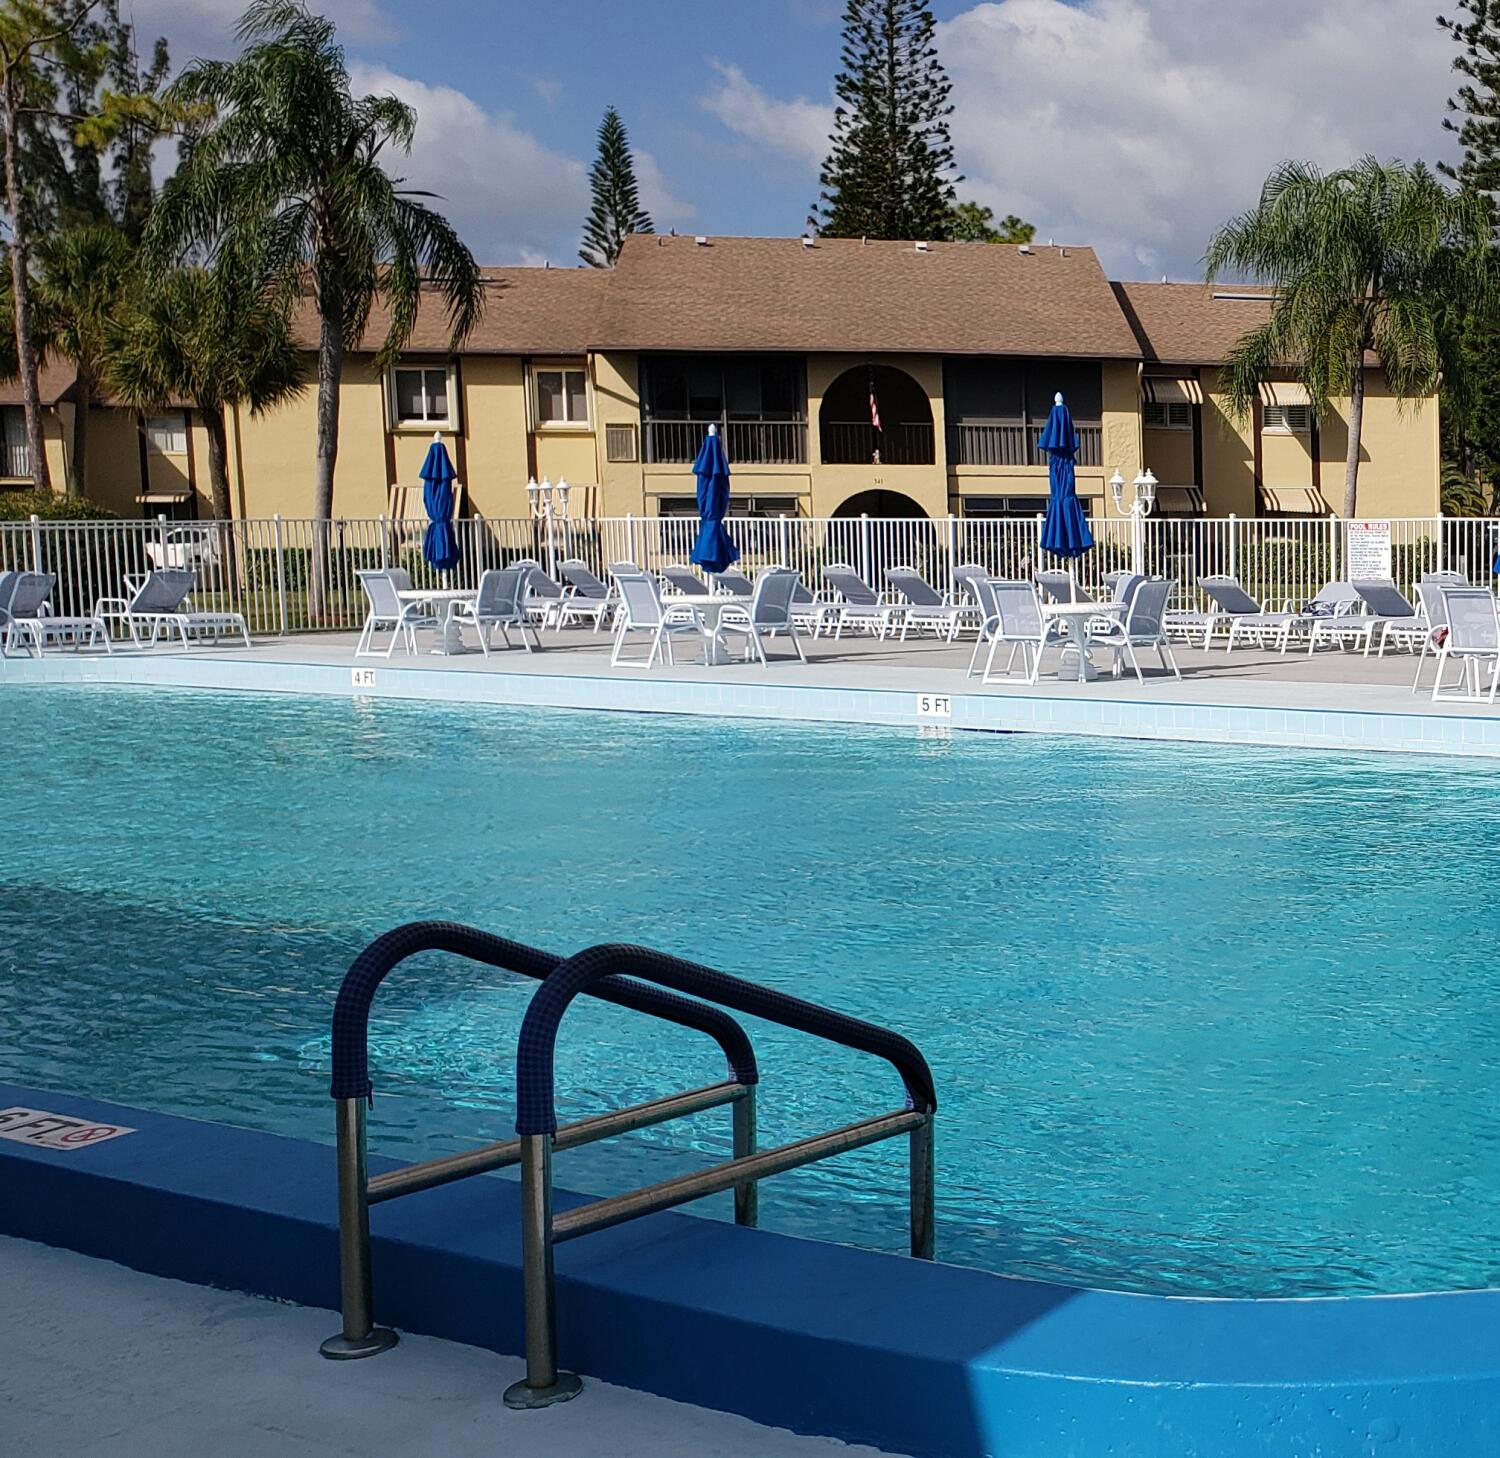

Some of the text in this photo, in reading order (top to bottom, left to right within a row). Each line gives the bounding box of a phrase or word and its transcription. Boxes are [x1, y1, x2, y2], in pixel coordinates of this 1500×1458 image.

[355, 671, 360, 684] 4
[922, 697, 950, 713] 5 FT.
[3, 1117, 85, 1140] FT.
